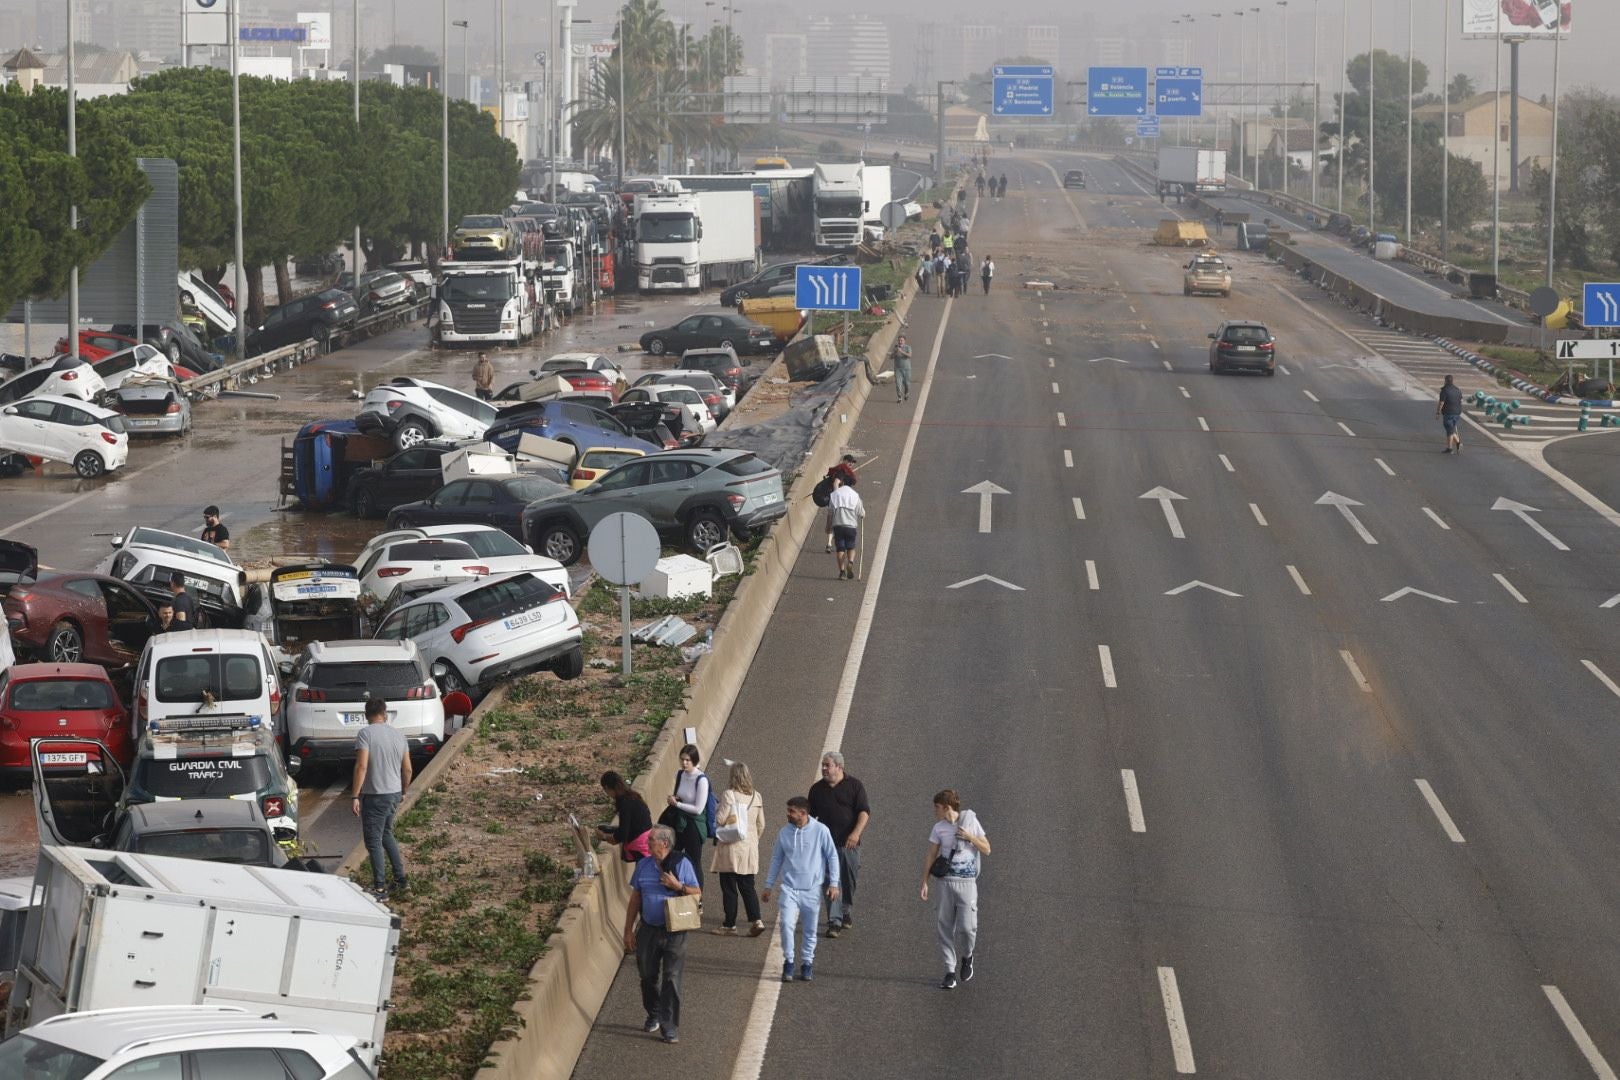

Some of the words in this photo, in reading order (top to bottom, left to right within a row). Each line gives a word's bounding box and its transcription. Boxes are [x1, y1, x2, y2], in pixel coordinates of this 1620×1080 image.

[510, 615, 528, 626] 6439
[528, 611, 542, 621] LSD
[47, 754, 67, 762] 1375
[169, 760, 215, 771] GUARDIA
[218, 760, 242, 769] CIVIL
[335, 934, 347, 971] SODECA
